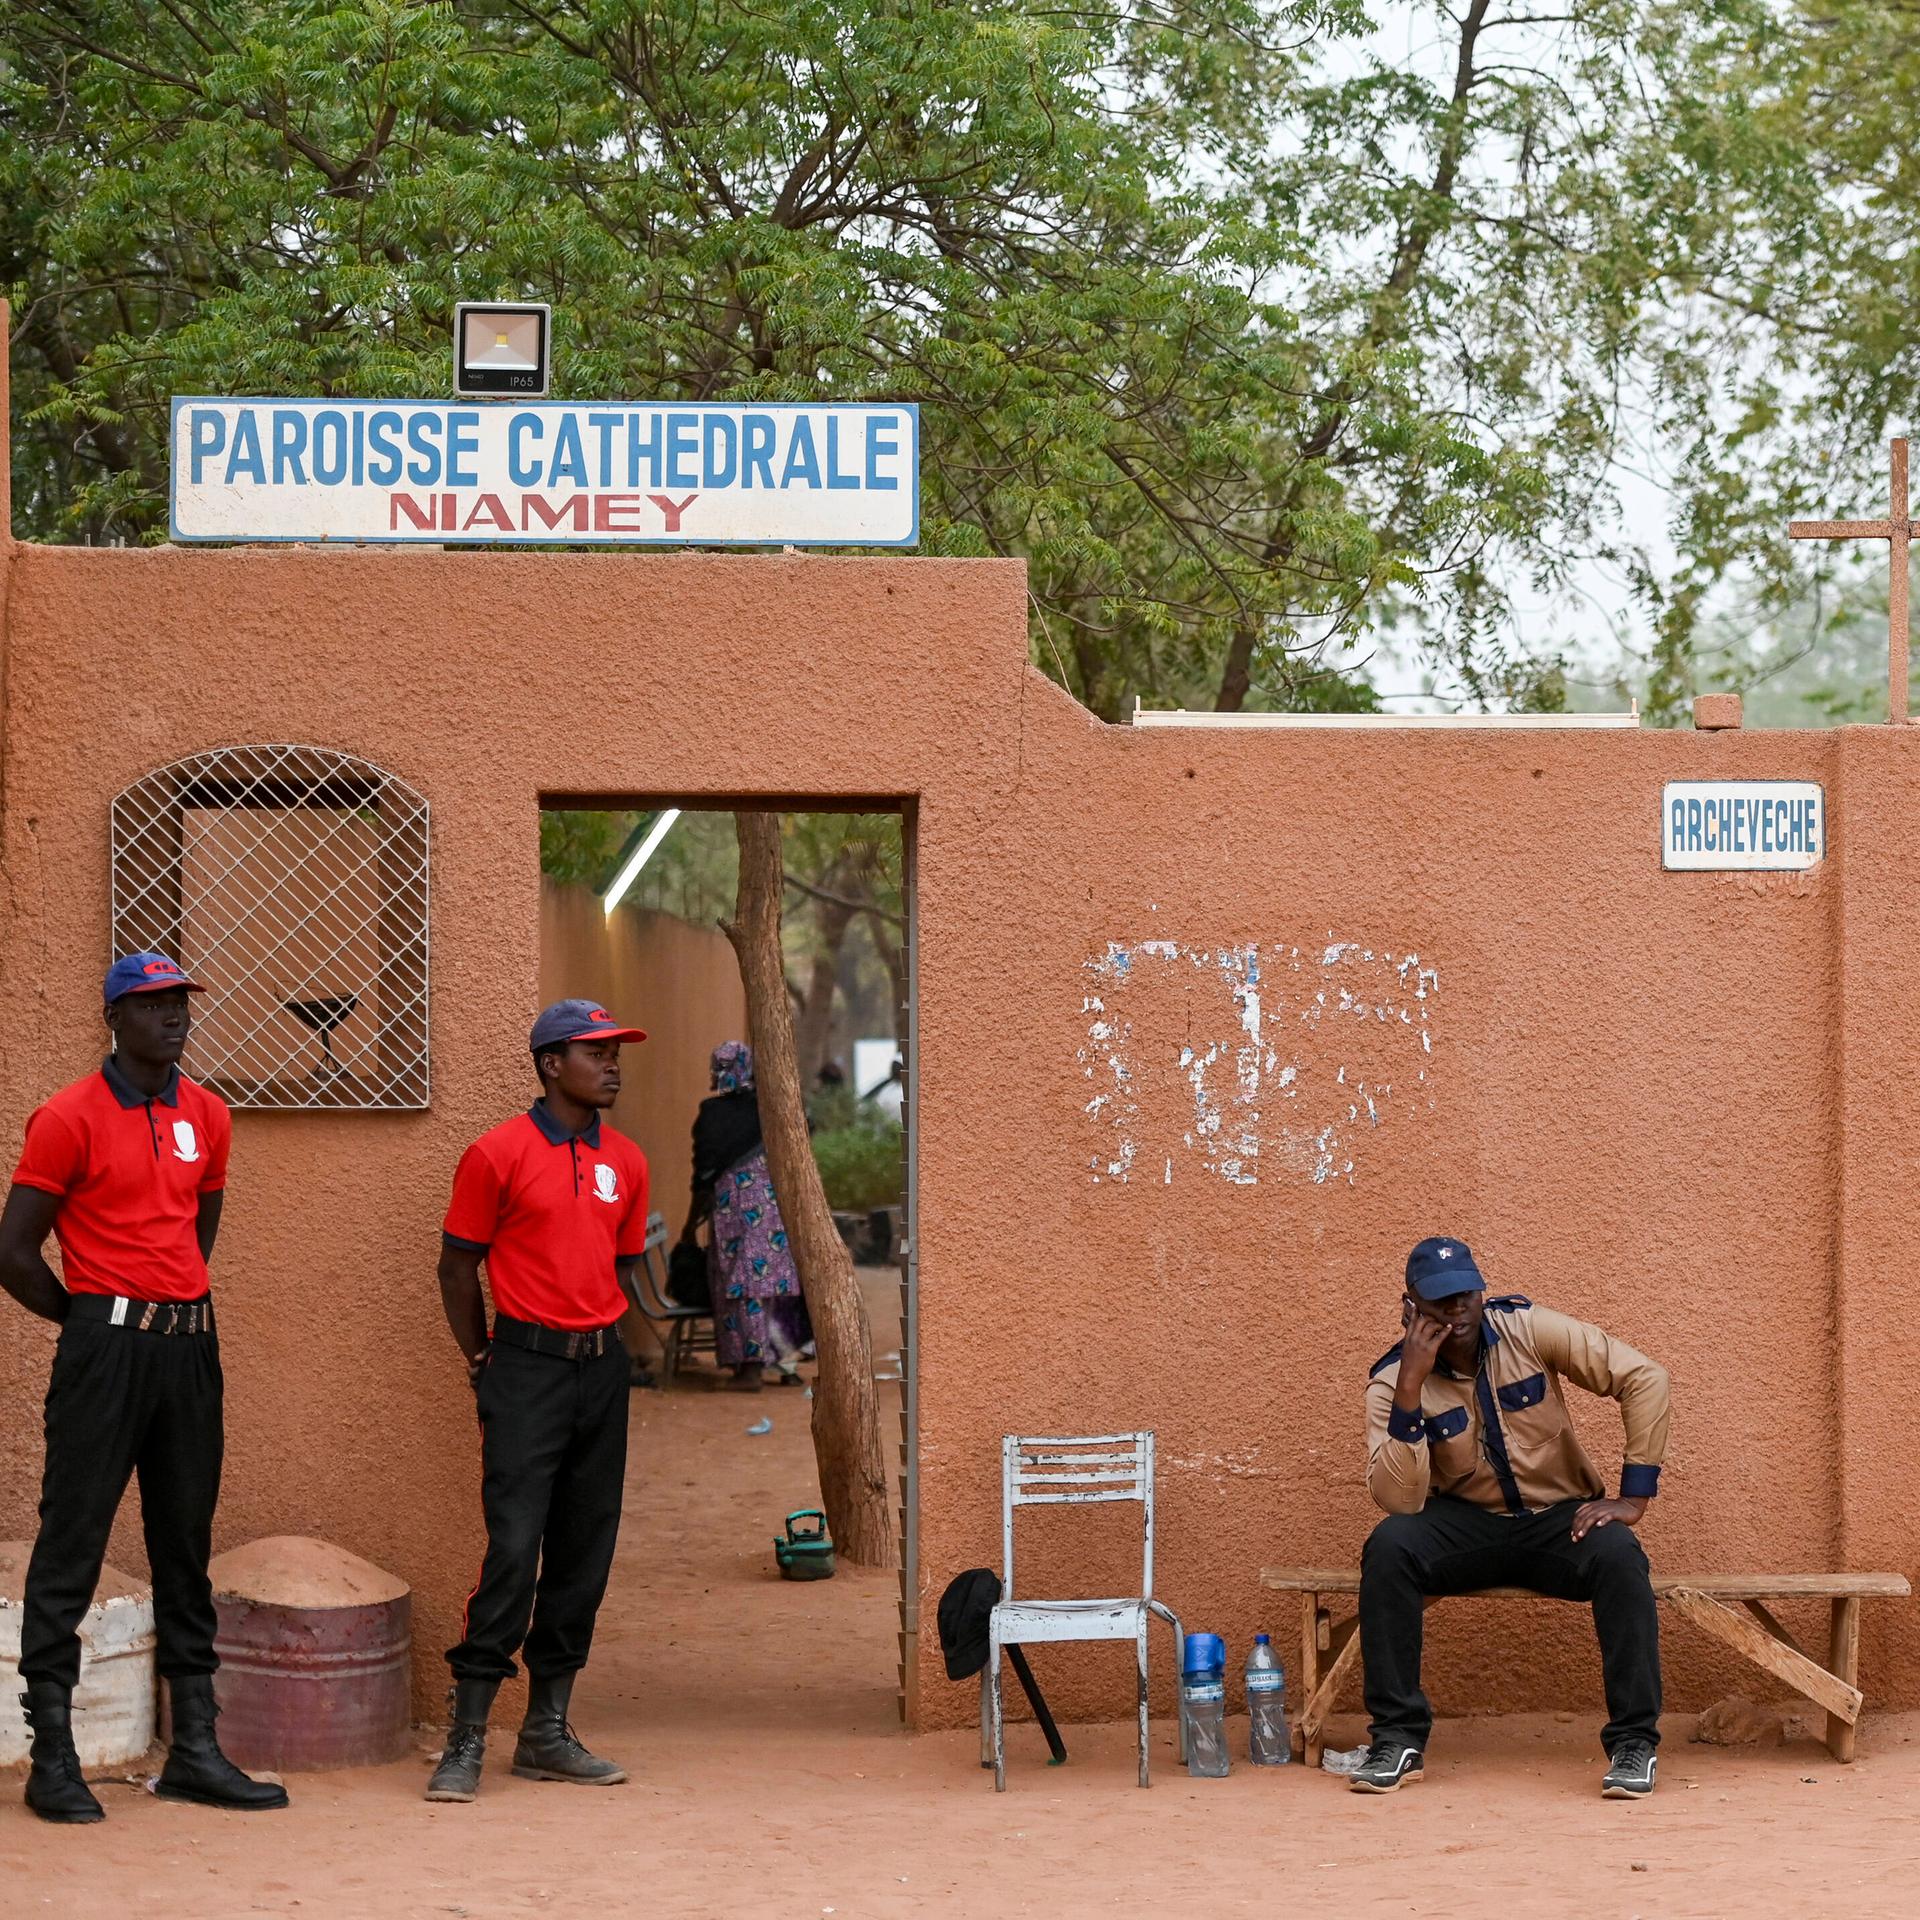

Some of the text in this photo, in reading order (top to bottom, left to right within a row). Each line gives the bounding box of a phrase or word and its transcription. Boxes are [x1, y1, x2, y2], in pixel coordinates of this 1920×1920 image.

[510, 376, 534, 387] IP65
[190, 410, 899, 491] PAROISSE CATHEDRALE
[389, 493, 700, 532] NIAMEY
[1671, 798, 1816, 853] ARCHEVECHE
